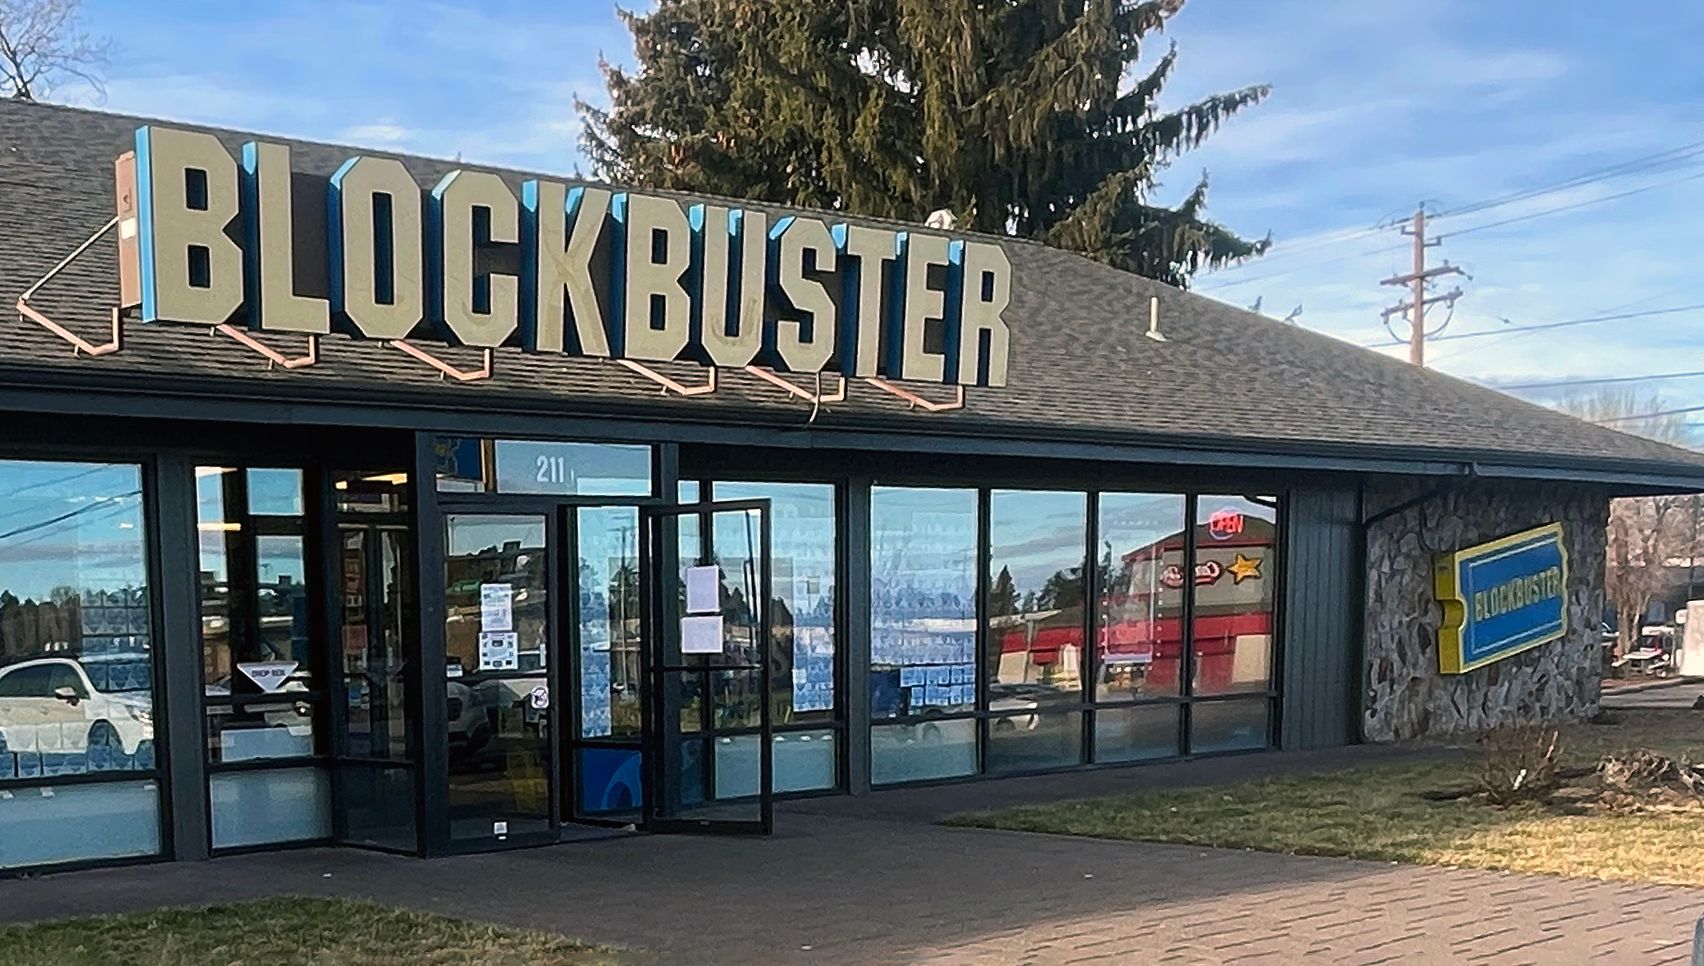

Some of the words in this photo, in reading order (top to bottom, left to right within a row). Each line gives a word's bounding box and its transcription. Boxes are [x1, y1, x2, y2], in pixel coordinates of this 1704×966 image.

[139, 125, 1013, 389] BLOCKBUSTER
[536, 455, 565, 483] 211
[1474, 566, 1562, 622] BLOCKBUSTER
